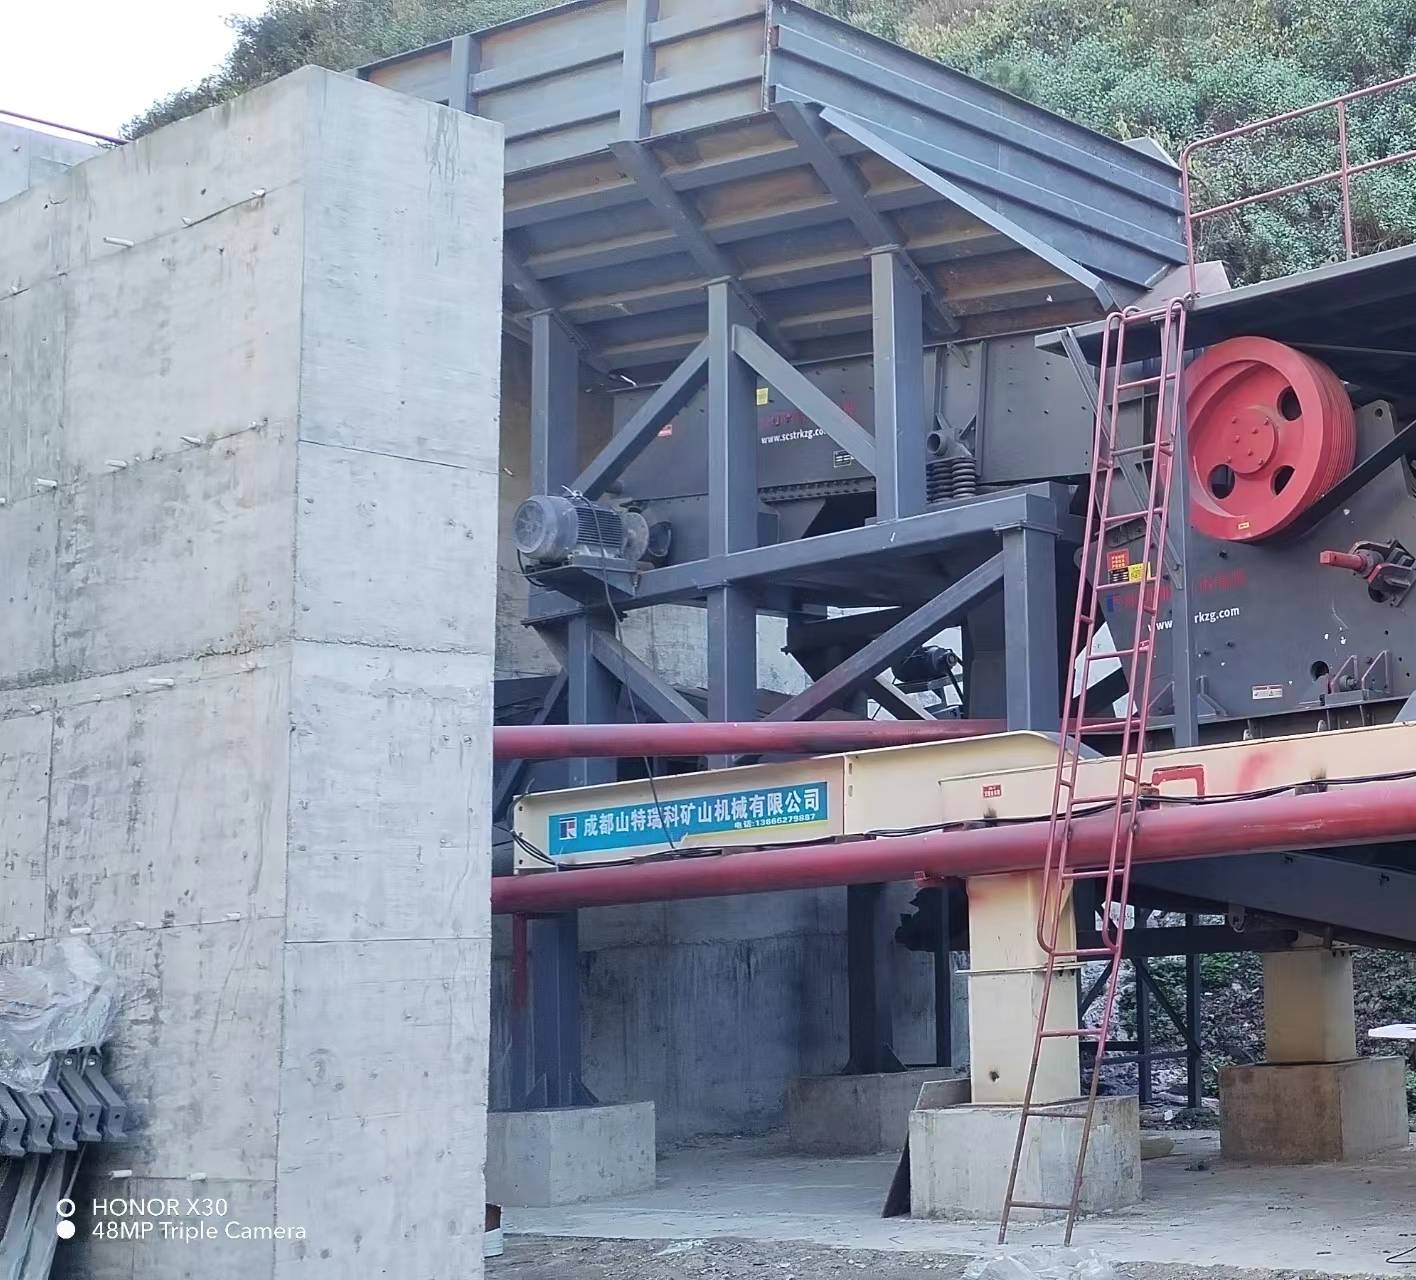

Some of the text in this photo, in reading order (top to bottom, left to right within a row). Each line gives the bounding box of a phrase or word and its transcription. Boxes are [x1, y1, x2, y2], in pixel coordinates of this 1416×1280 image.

[761, 427, 826, 444] www.scstrkzg.co
[583, 788, 820, 837] 成都山特瑞科矿山机械有限公司
